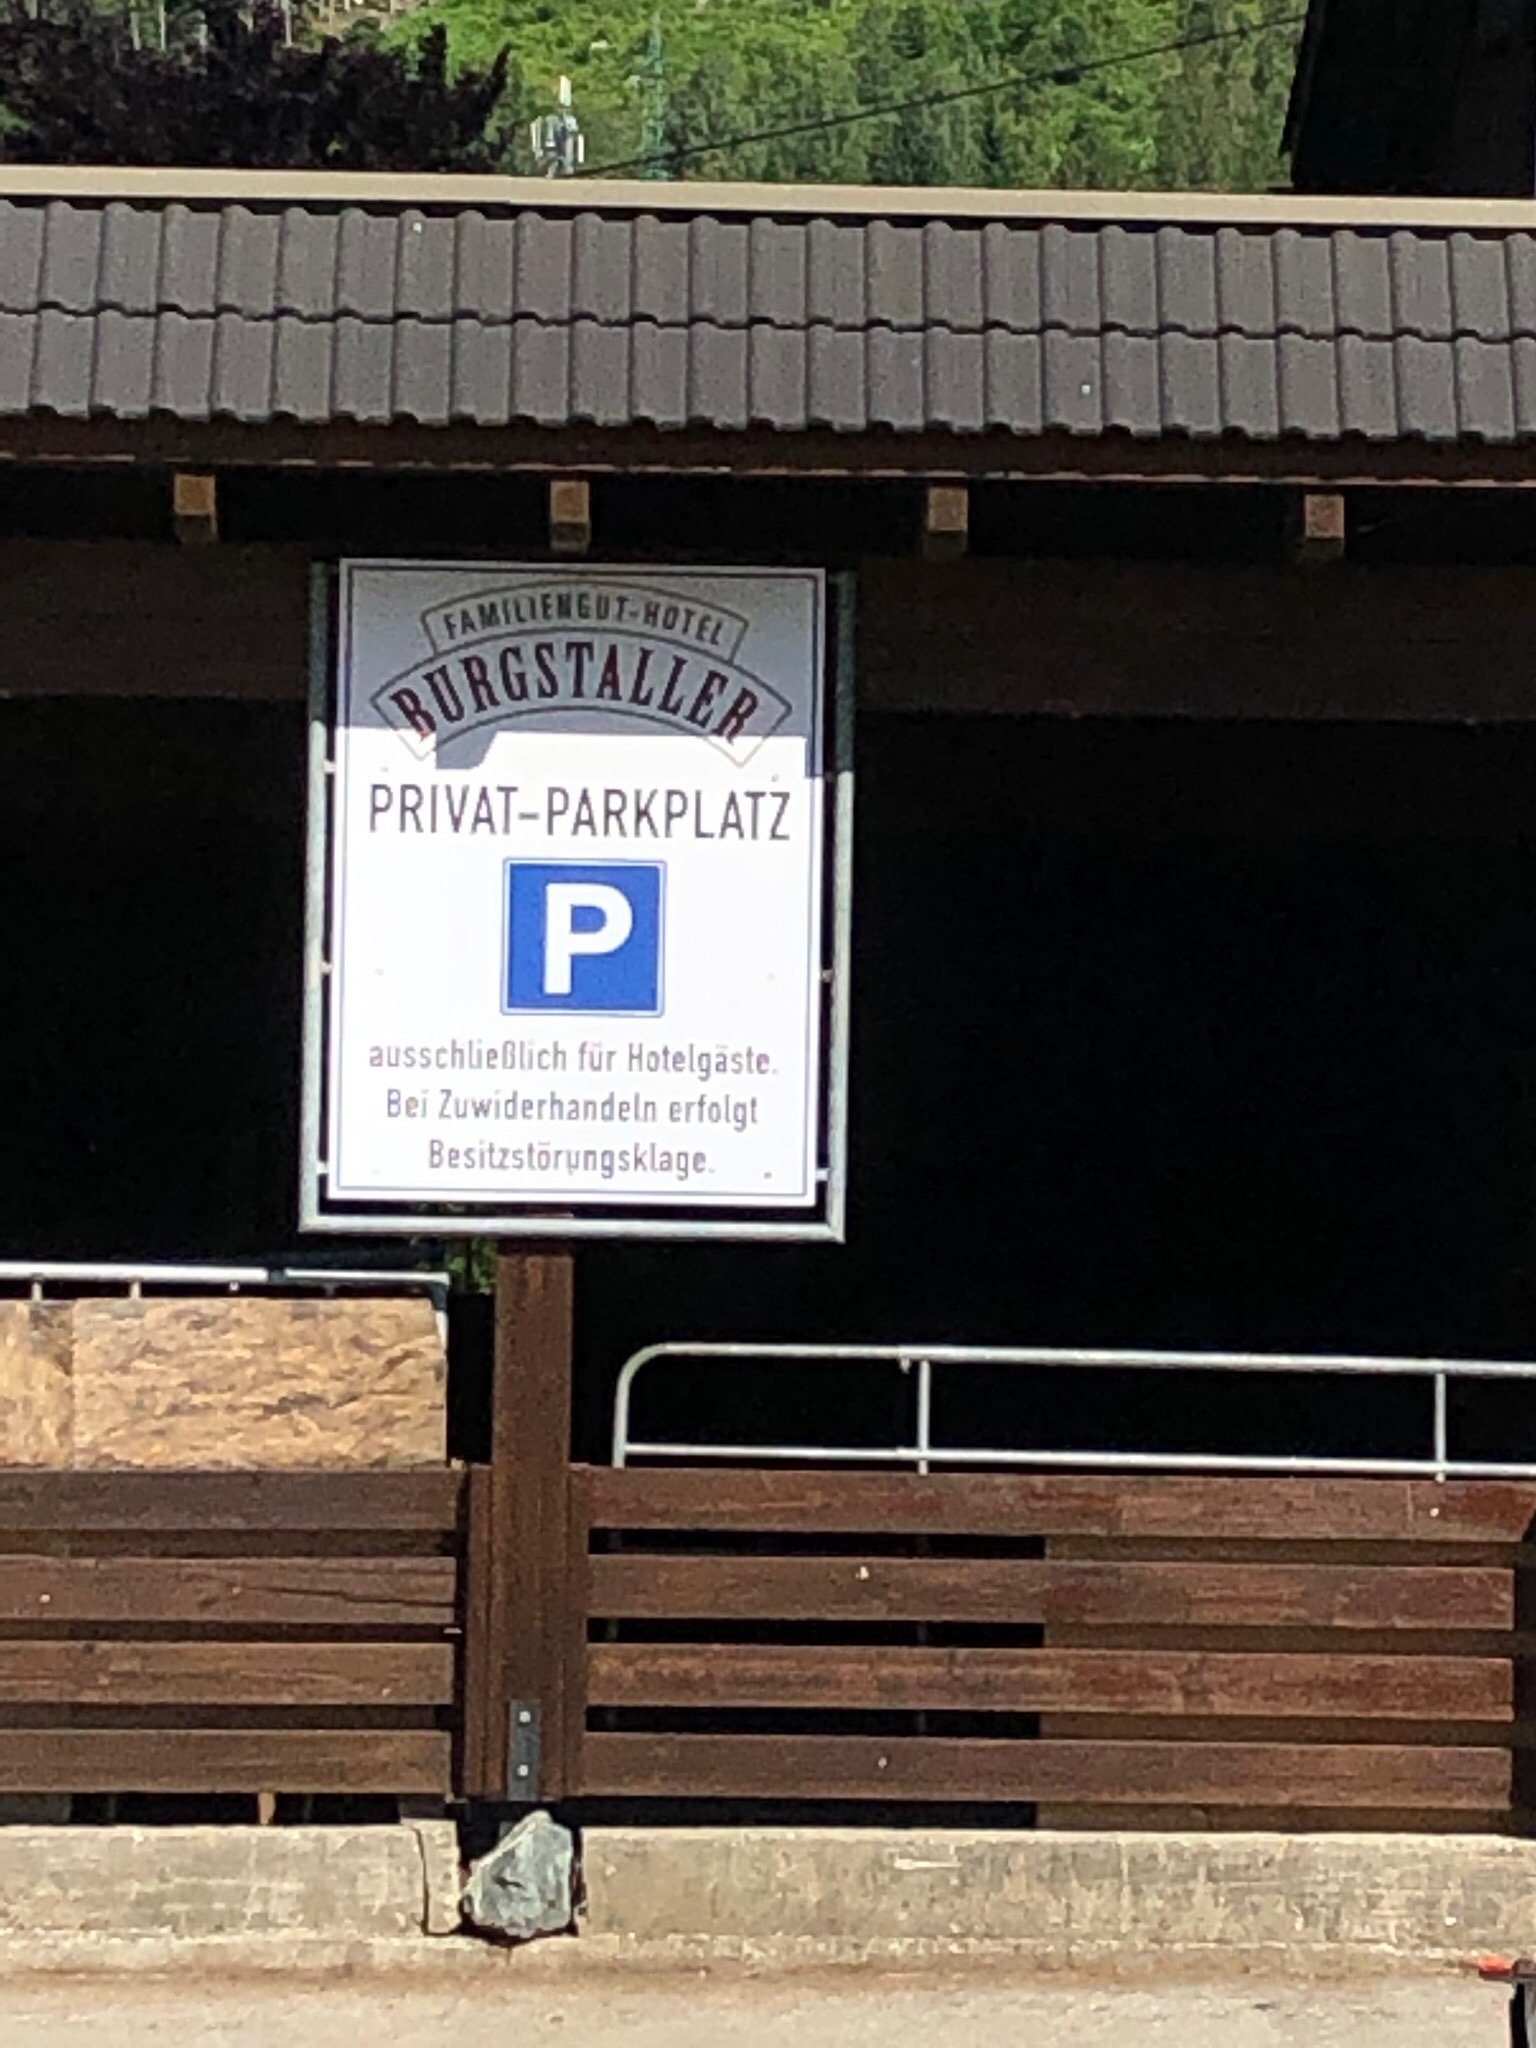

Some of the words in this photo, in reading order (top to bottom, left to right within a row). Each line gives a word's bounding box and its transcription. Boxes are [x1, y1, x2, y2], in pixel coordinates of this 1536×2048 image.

[443, 592, 723, 646] FAMILIENGUT-HOTEL
[390, 641, 761, 743] BURGSTALLER
[369, 783, 791, 841] PRIVAT-PARKPLATZ
[544, 882, 634, 995] P
[369, 1039, 567, 1073] ausschließlich
[578, 1040, 617, 1073] für
[627, 1042, 779, 1081] Hotelgäste.
[386, 1088, 427, 1119] Bei
[437, 1089, 657, 1123] Zuwiderhandeln
[668, 1093, 759, 1131] erfolgt
[428, 1139, 716, 1180] Besitzstörungsklage.
